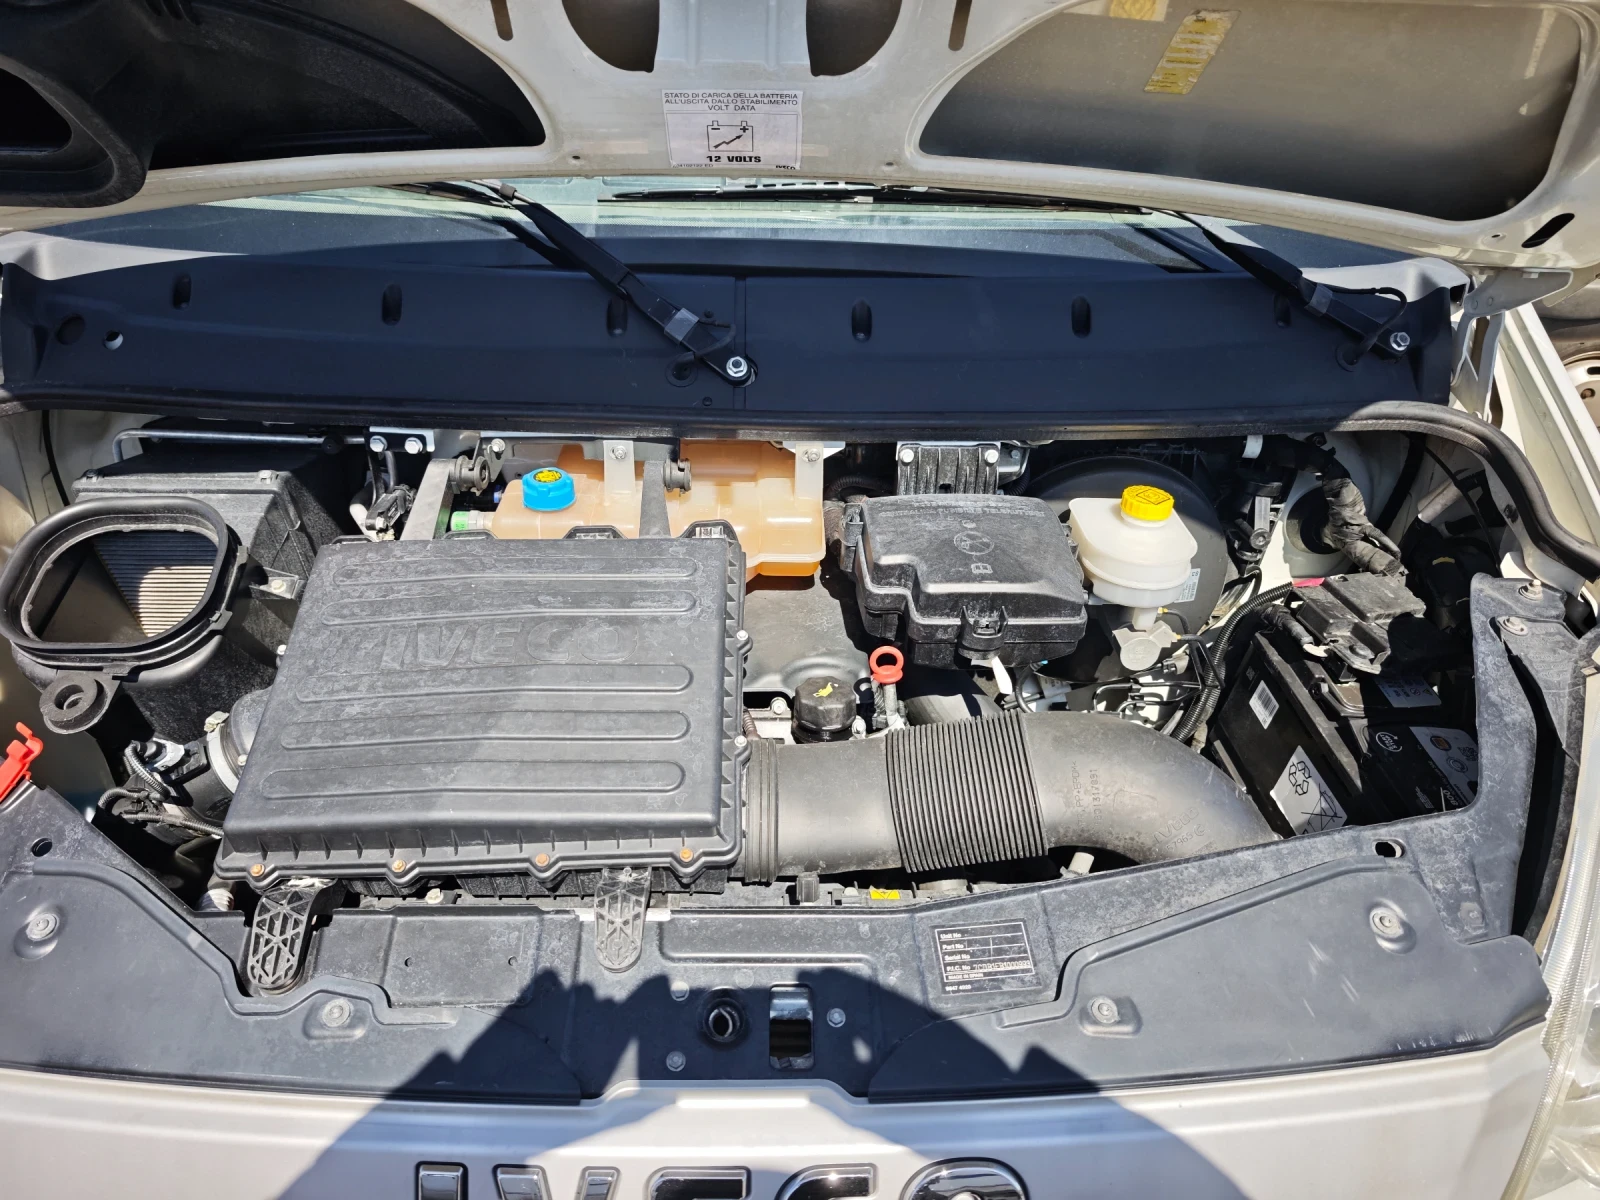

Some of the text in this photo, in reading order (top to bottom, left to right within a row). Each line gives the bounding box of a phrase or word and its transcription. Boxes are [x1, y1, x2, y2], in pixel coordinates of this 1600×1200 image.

[740, 98, 798, 106] STABILIMENTO
[706, 155, 762, 163] 12 VOLTS
[380, 621, 639, 671] IVECO
